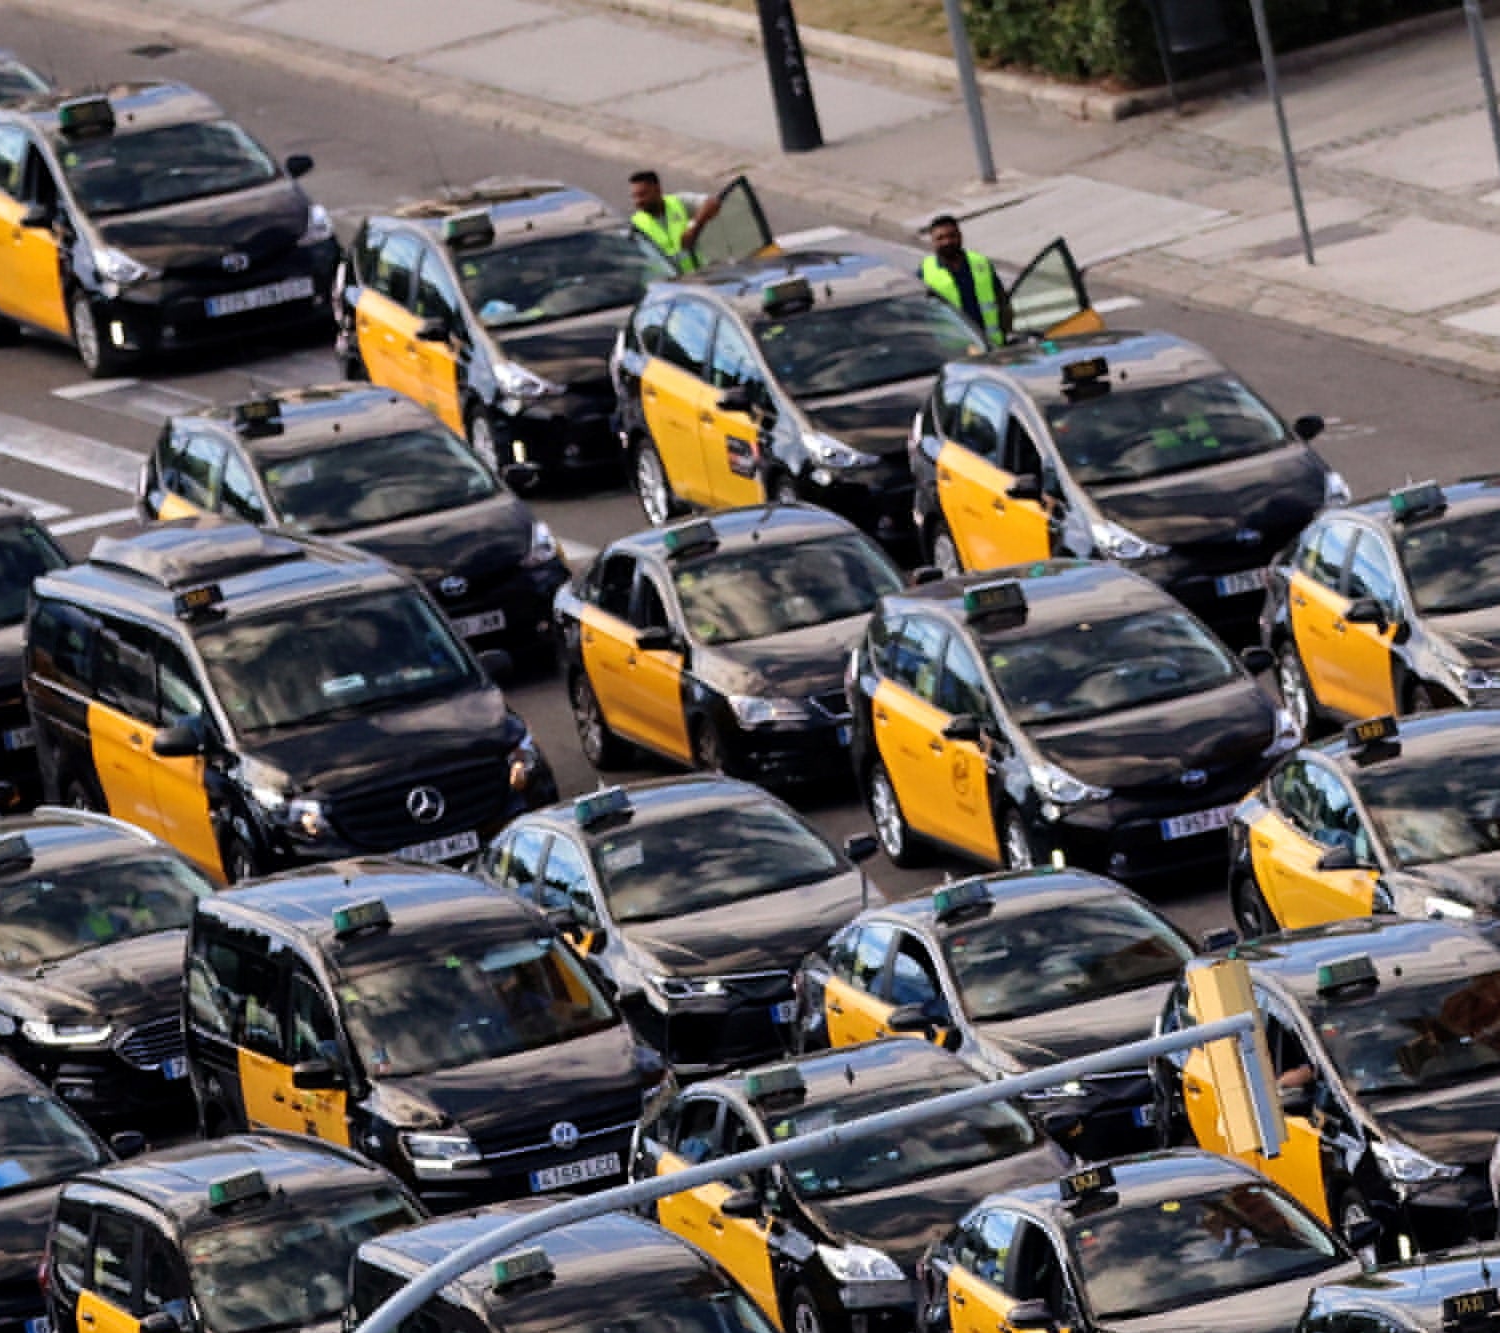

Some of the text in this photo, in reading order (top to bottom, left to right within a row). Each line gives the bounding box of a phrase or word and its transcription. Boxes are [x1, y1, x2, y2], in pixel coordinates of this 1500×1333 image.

[1358, 723, 1384, 740] TAXI
[1072, 1171, 1100, 1189] TAXI
[1454, 1296, 1484, 1314] TAXI
